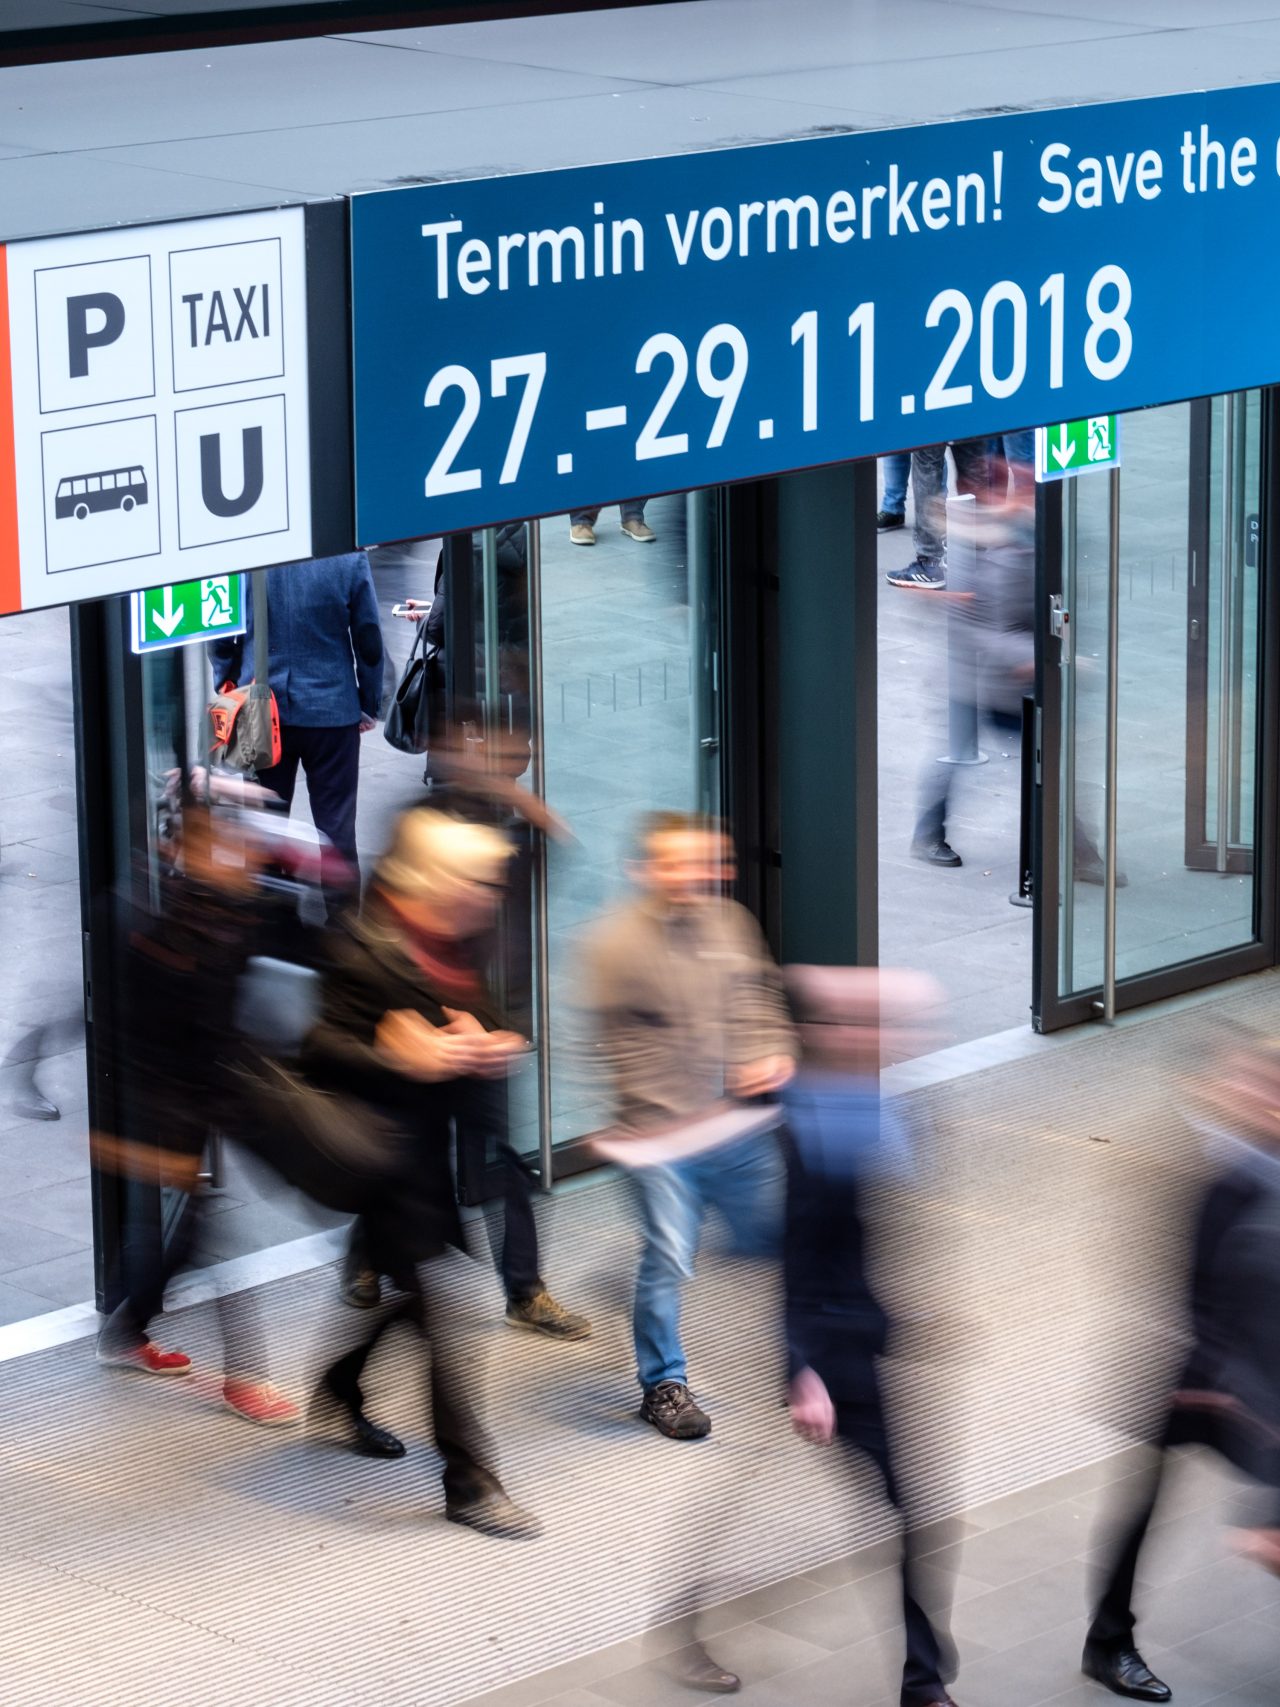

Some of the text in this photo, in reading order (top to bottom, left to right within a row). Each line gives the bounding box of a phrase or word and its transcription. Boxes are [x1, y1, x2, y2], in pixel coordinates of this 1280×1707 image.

[421, 202, 645, 300] Termin
[665, 150, 1004, 266] vormerken!
[1037, 142, 1163, 214] Save
[1180, 123, 1257, 194] the
[66, 292, 126, 379] P
[182, 283, 271, 348] TAXI
[423, 264, 1133, 498] 27.-29.11.2018
[199, 425, 264, 518] U
